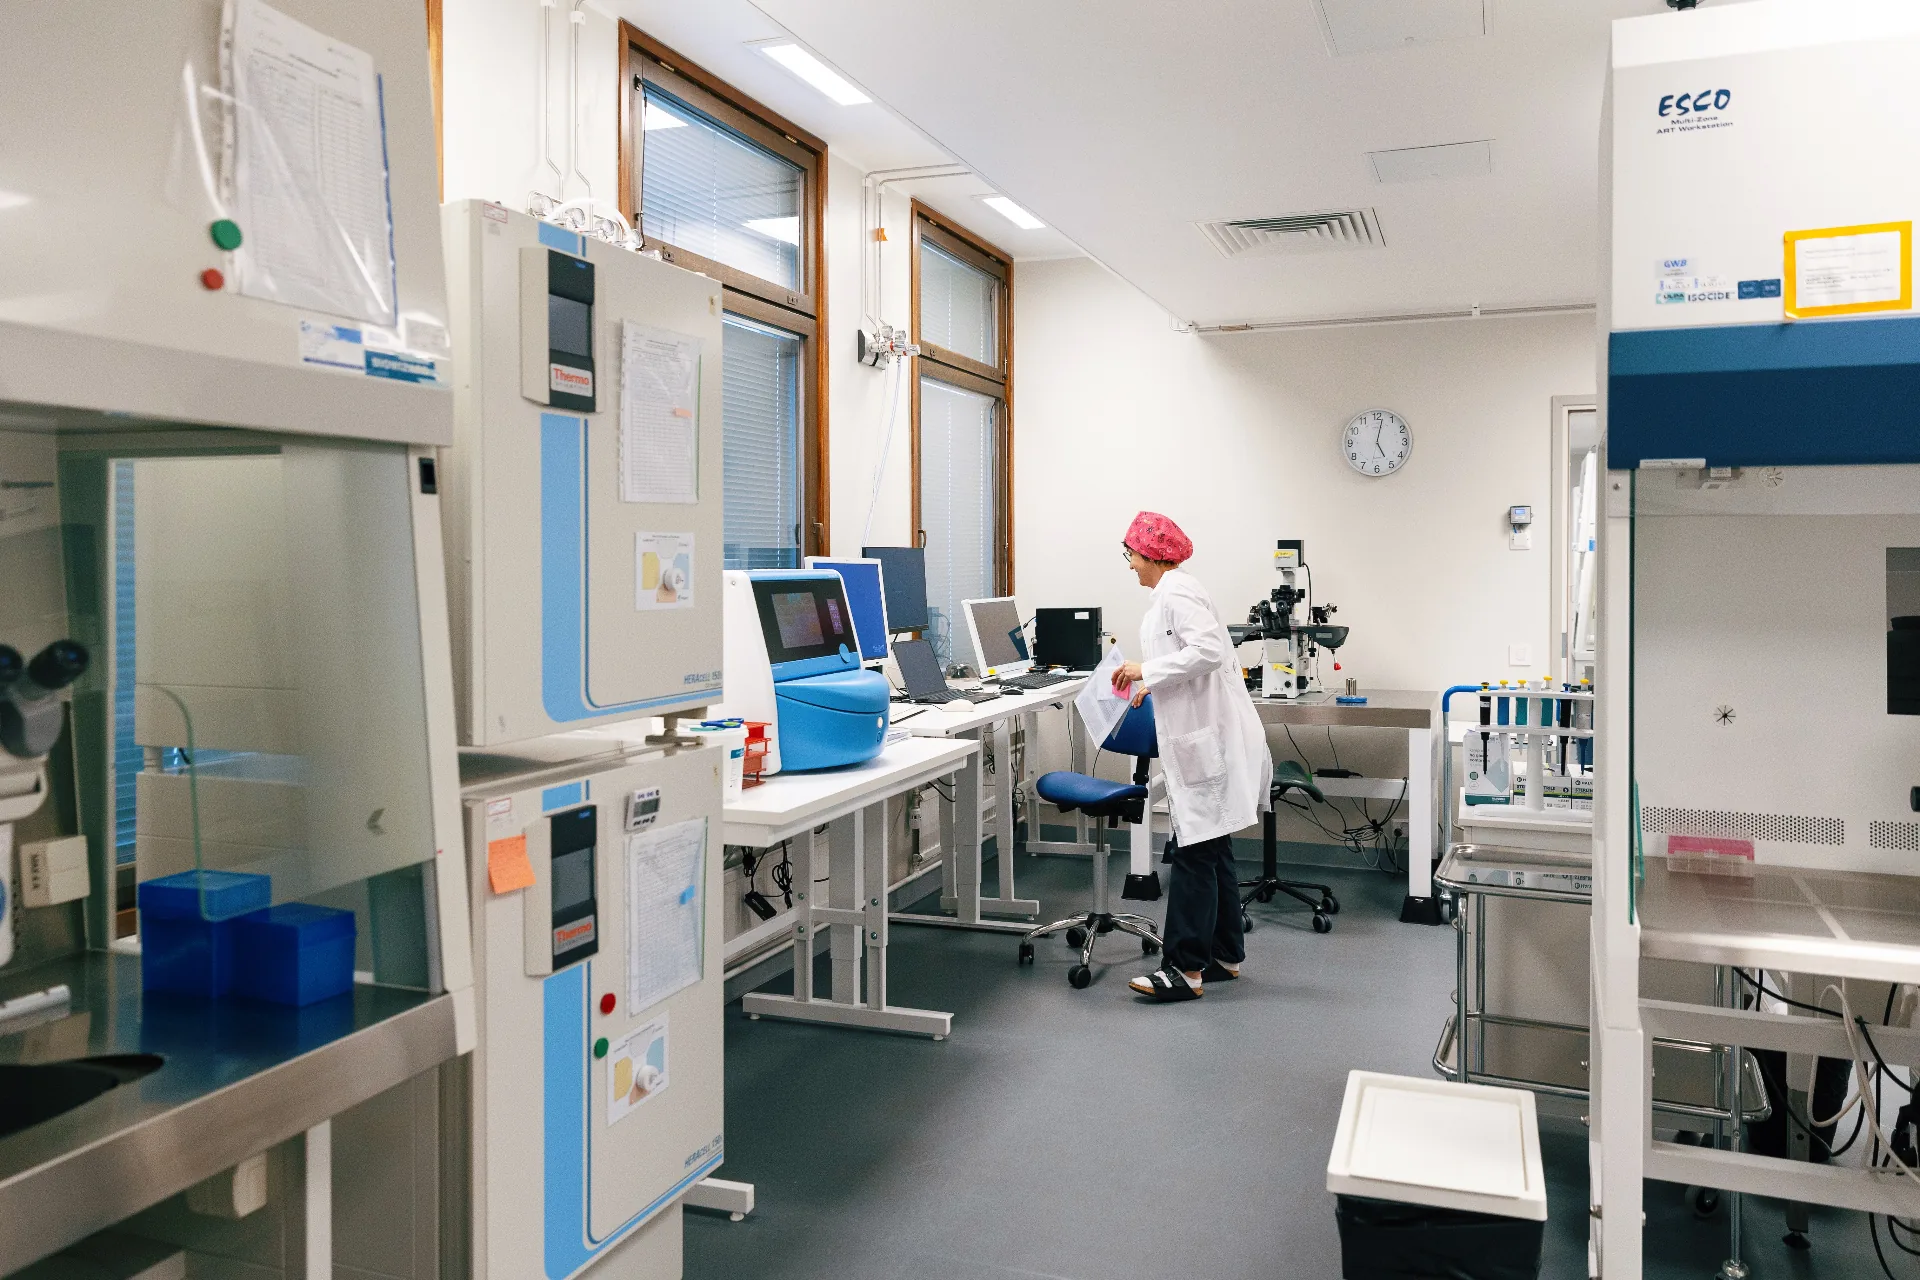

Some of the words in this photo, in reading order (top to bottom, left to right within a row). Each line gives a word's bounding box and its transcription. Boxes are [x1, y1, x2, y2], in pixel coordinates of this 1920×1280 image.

[1658, 89, 1731, 117] ESCO
[1671, 116, 1718, 125] Multi-Zone
[1679, 121, 1733, 132] Workstation
[1688, 291, 1730, 302] ISOCIDE
[553, 368, 590, 385] Thermo
[1359, 417, 1367, 425] 11
[1351, 427, 1359, 435] 10
[1347, 439, 1353, 448] 9
[1402, 438, 1408, 446] 3
[1351, 452, 1357, 460] 8
[1360, 461, 1366, 469] 7
[1374, 465, 1380, 473] 6
[1388, 461, 1395, 469] 5
[556, 921, 592, 943] Thermo
